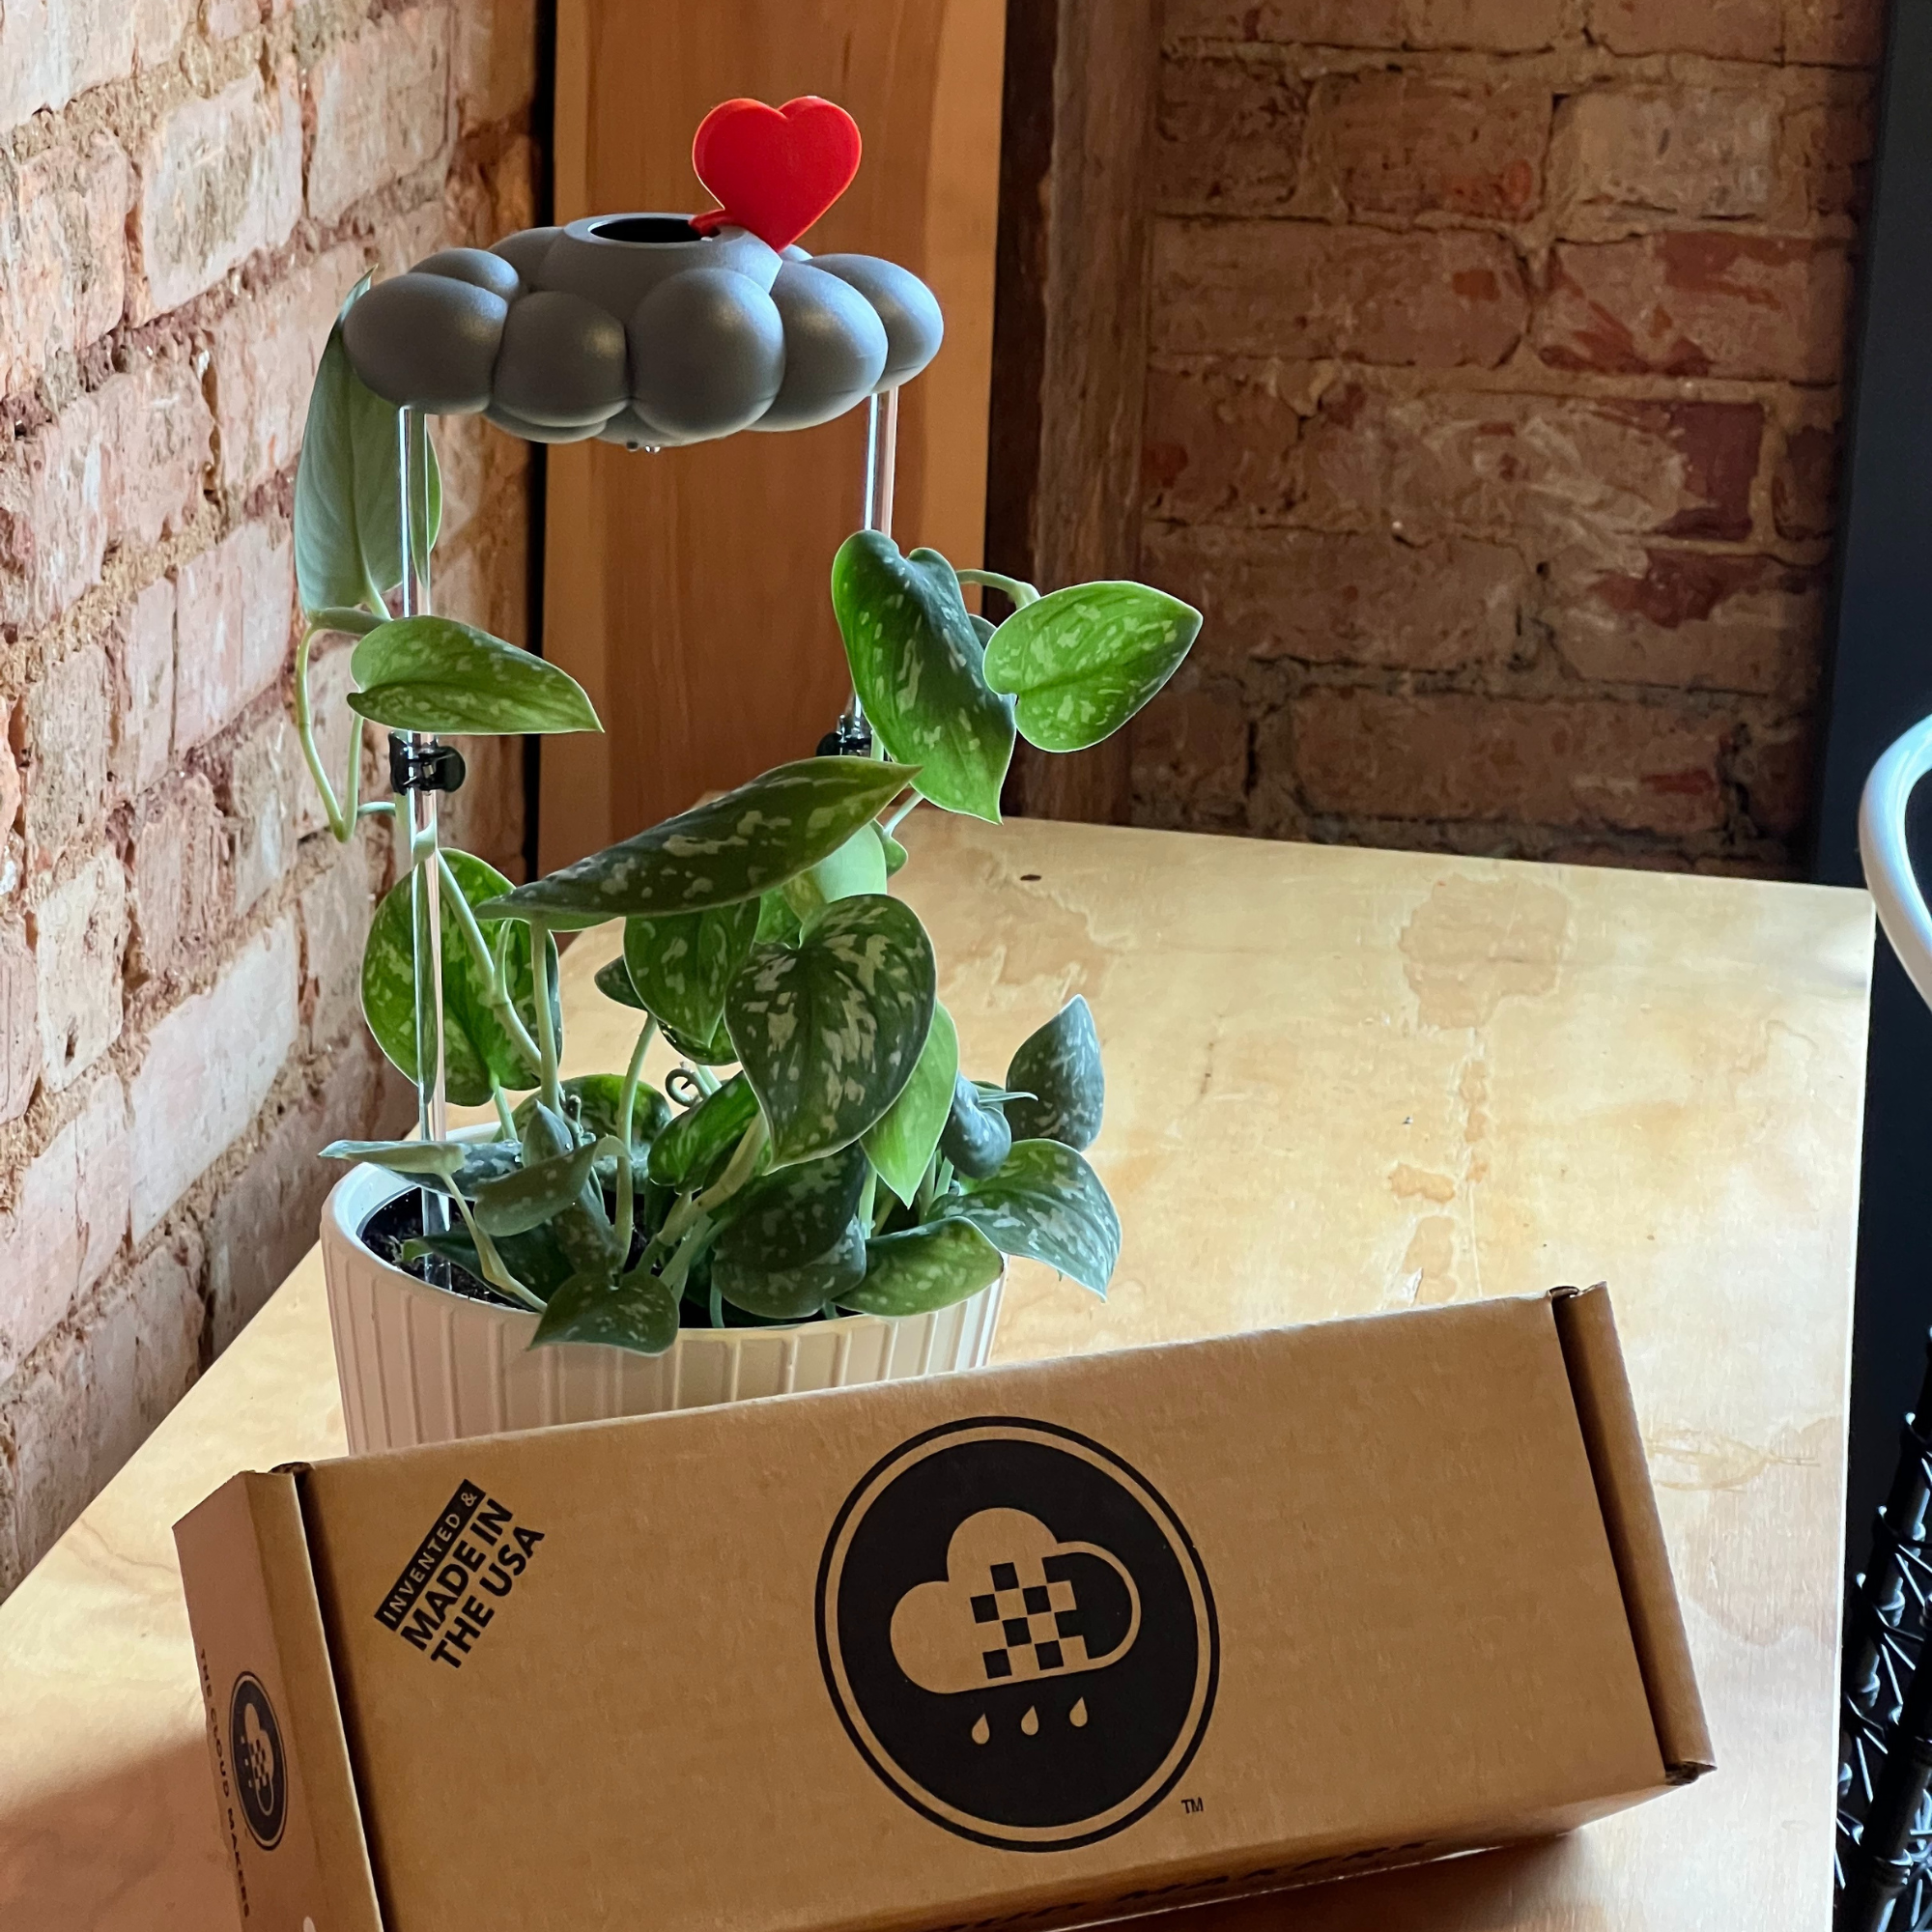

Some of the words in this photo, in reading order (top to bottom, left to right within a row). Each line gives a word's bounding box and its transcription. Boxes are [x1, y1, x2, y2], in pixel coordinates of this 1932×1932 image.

[384, 1513, 461, 1622] INVENTED
[461, 1492, 477, 1507] &
[400, 1540, 487, 1652] MADE
[469, 1498, 513, 1547] IN
[430, 1595, 495, 1668] THE
[479, 1526, 545, 1597] USA
[201, 1648, 213, 1698] THE
[211, 1707, 230, 1798] CLOUD
[1180, 1797, 1204, 1814] TM
